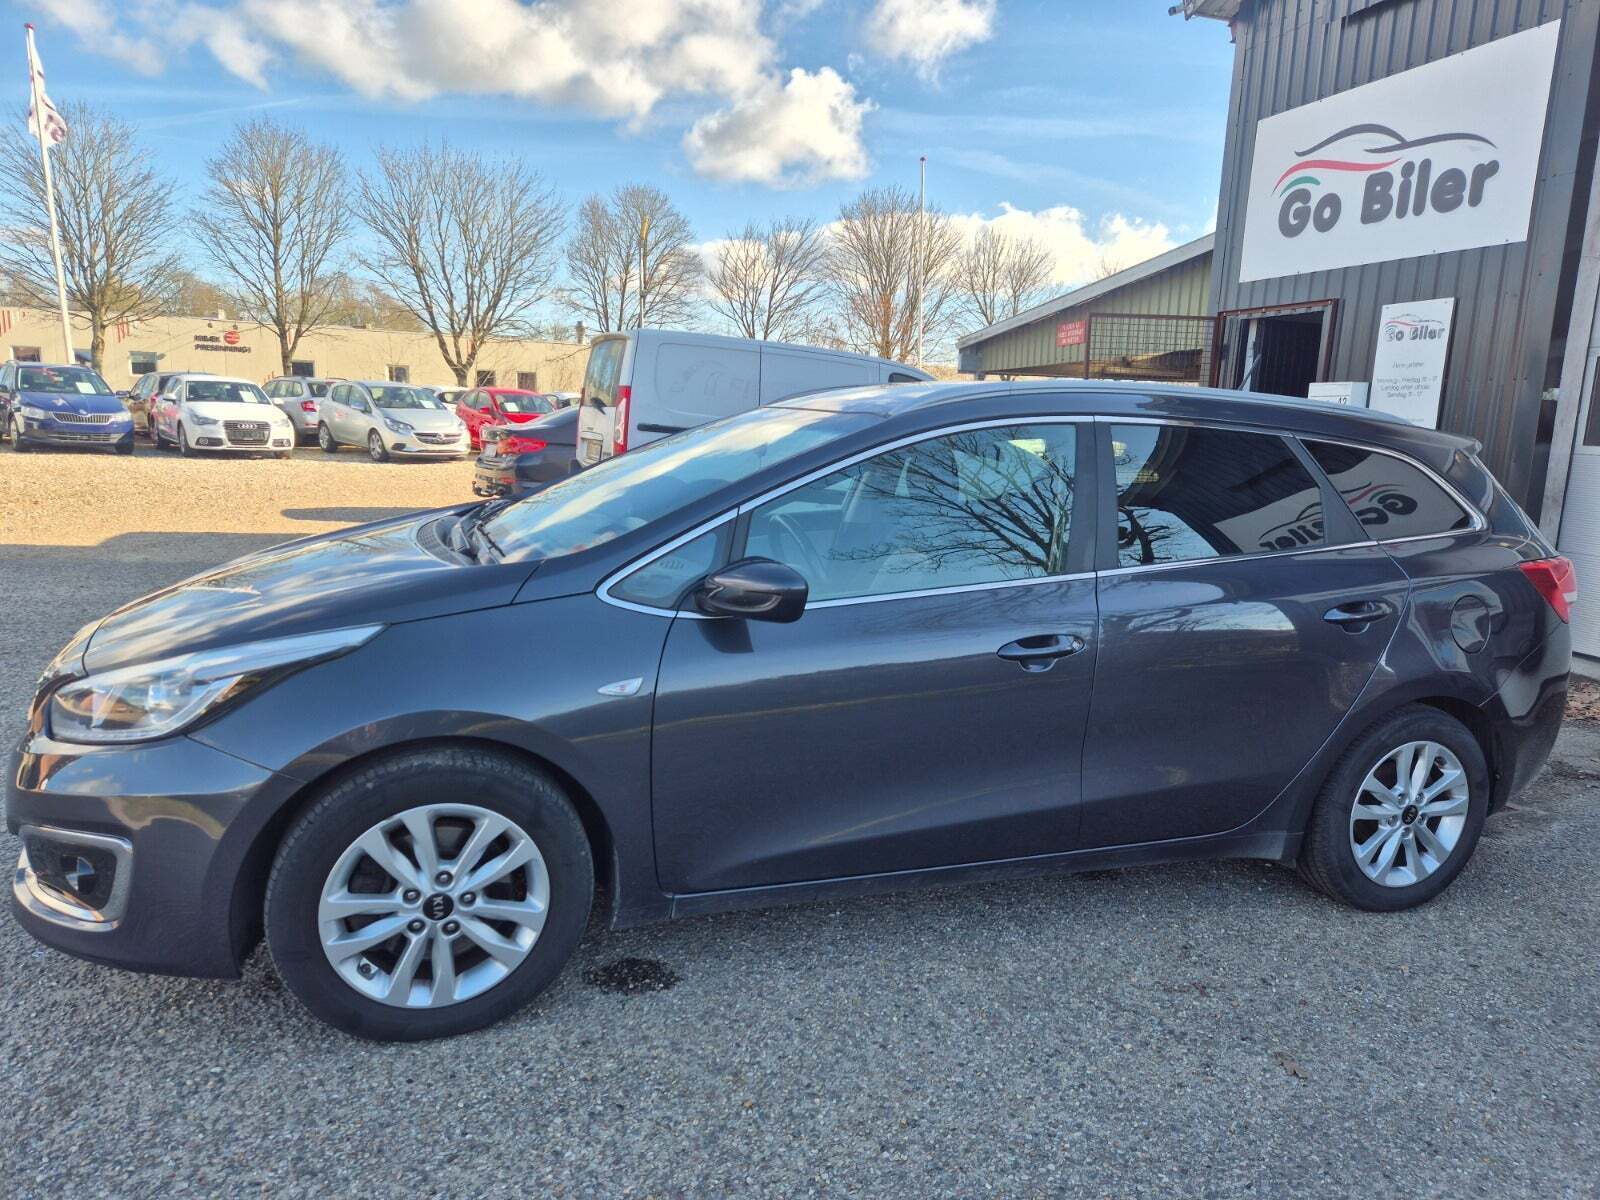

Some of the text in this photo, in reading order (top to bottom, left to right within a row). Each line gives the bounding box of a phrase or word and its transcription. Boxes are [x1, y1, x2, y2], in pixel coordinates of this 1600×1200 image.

[1278, 158, 1500, 239] Go Biler
[1385, 325, 1446, 342] Go Biler
[432, 896, 445, 919] KIA
